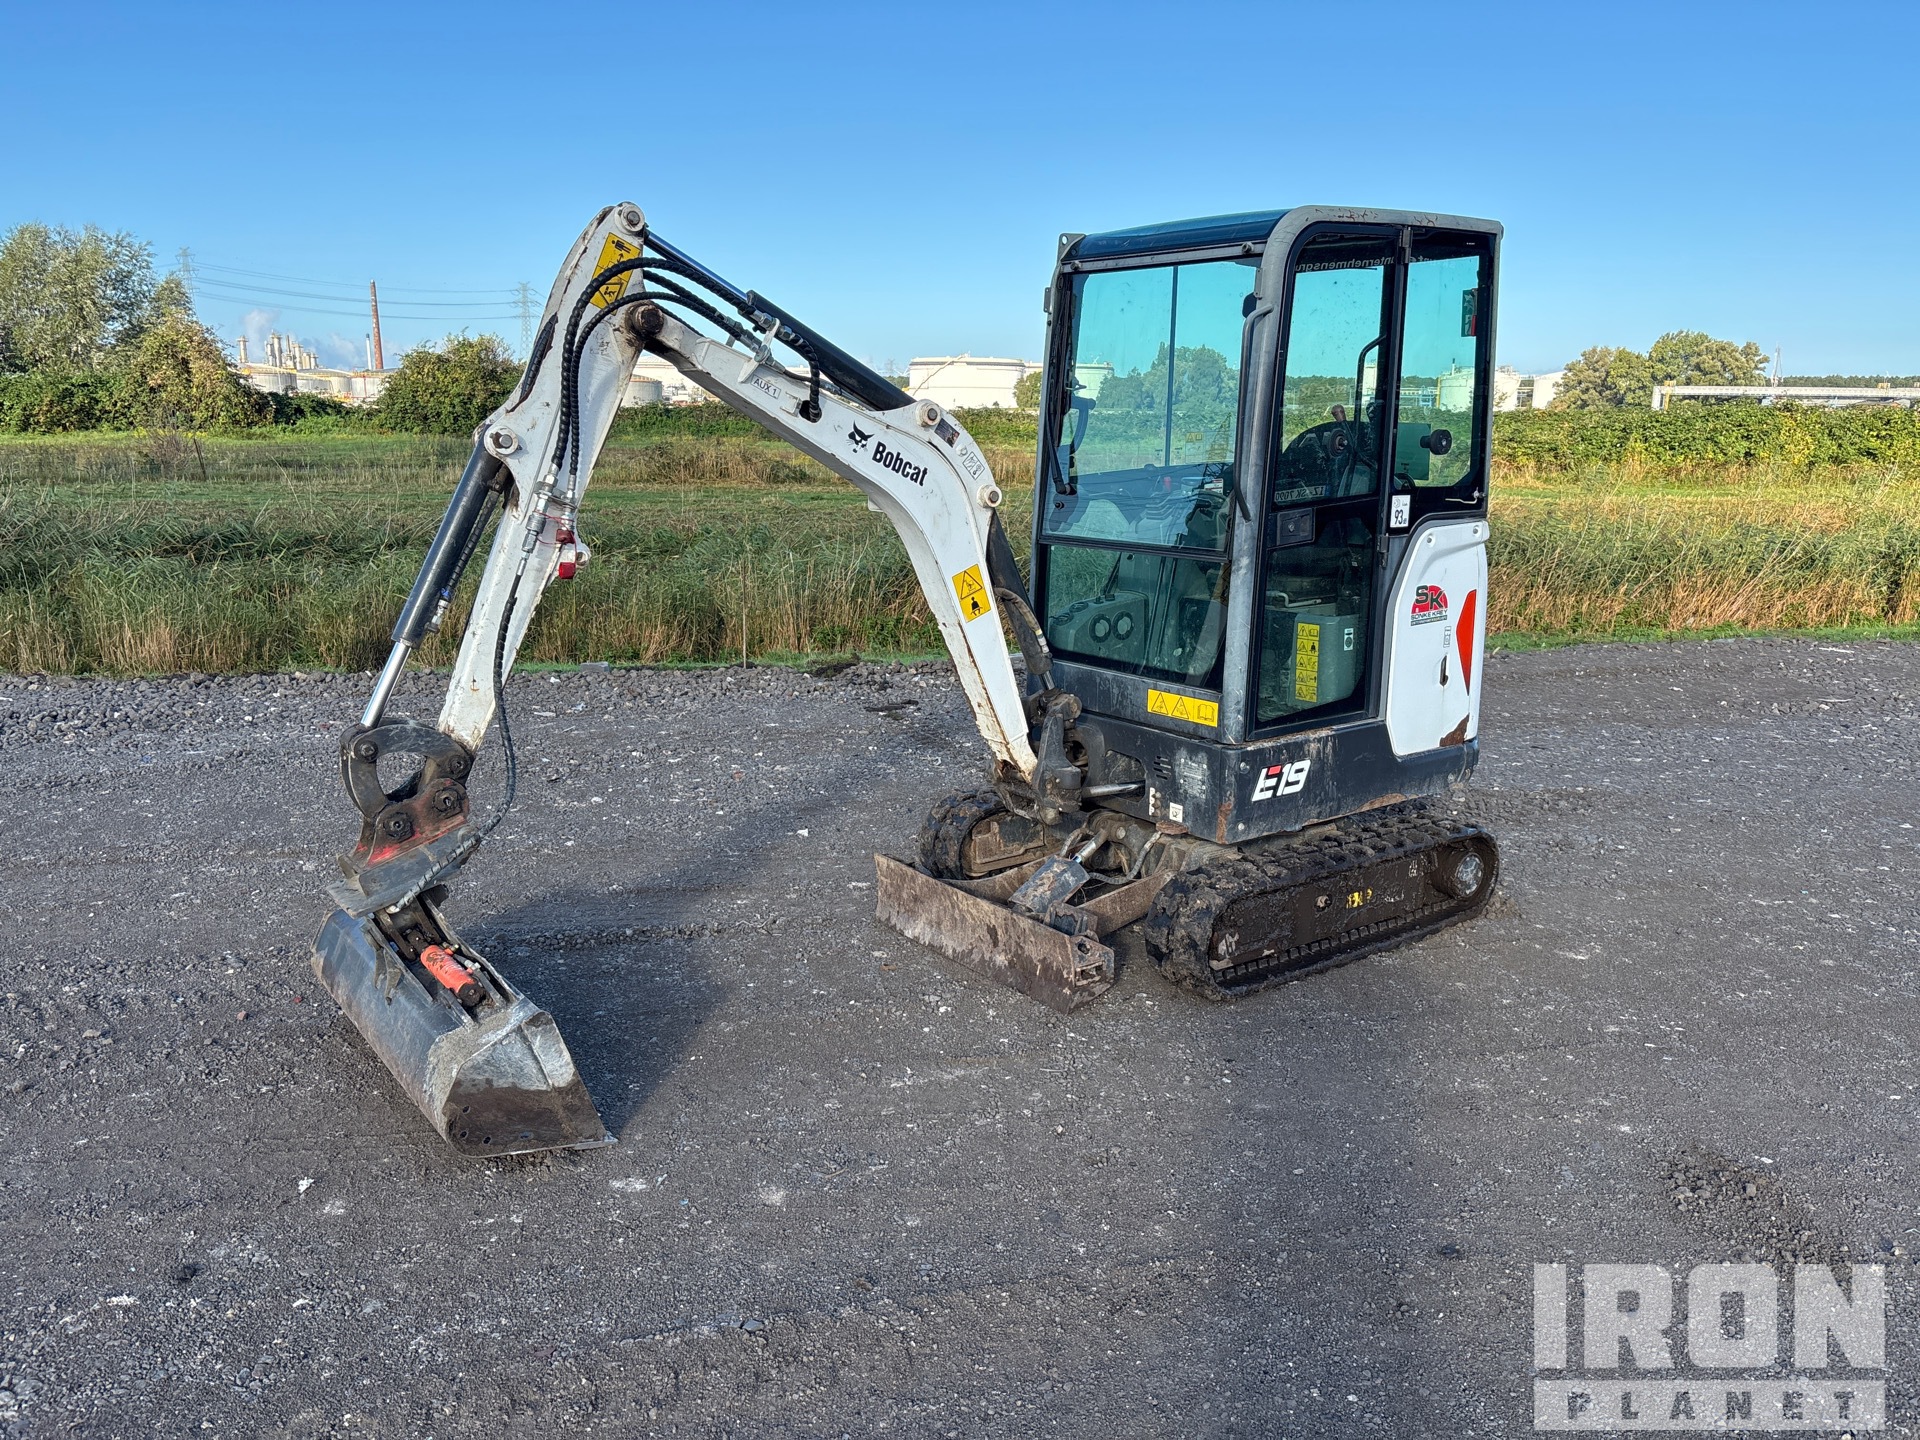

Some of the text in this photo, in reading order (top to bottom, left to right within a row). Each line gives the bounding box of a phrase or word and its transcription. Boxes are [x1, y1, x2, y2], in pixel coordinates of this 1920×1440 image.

[753, 378, 772, 393] AUX
[871, 441, 928, 487] Bobcat
[1394, 509, 1404, 525] 93
[1415, 585, 1444, 609] SK
[1251, 759, 1311, 802] E19
